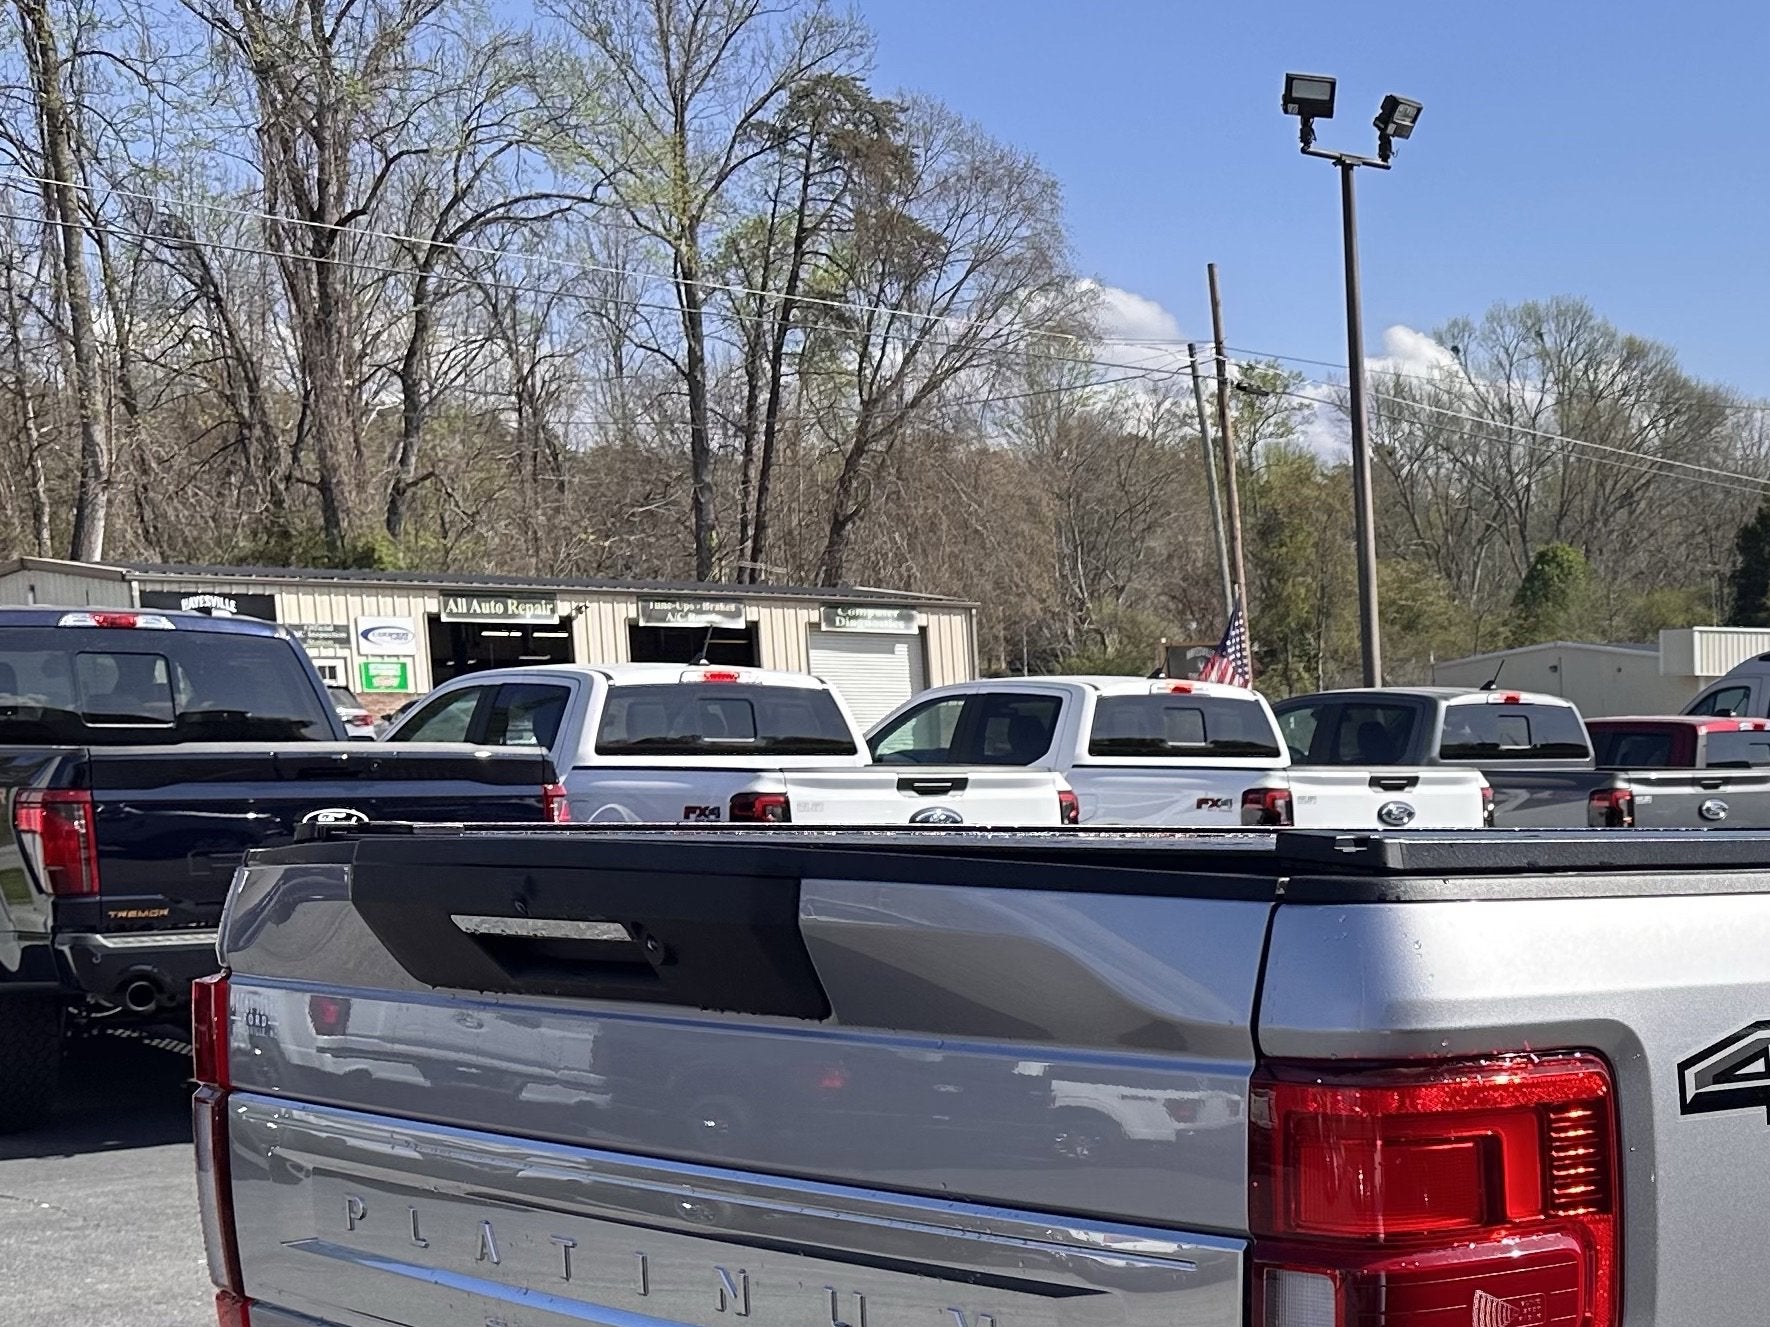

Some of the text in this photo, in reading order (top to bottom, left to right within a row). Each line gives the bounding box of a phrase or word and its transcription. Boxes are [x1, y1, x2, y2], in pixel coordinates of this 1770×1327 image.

[446, 598, 553, 618] All Auto Repair
[1196, 798, 1233, 810] FX4
[683, 805, 721, 820] FX4
[108, 907, 169, 918] TREMOR
